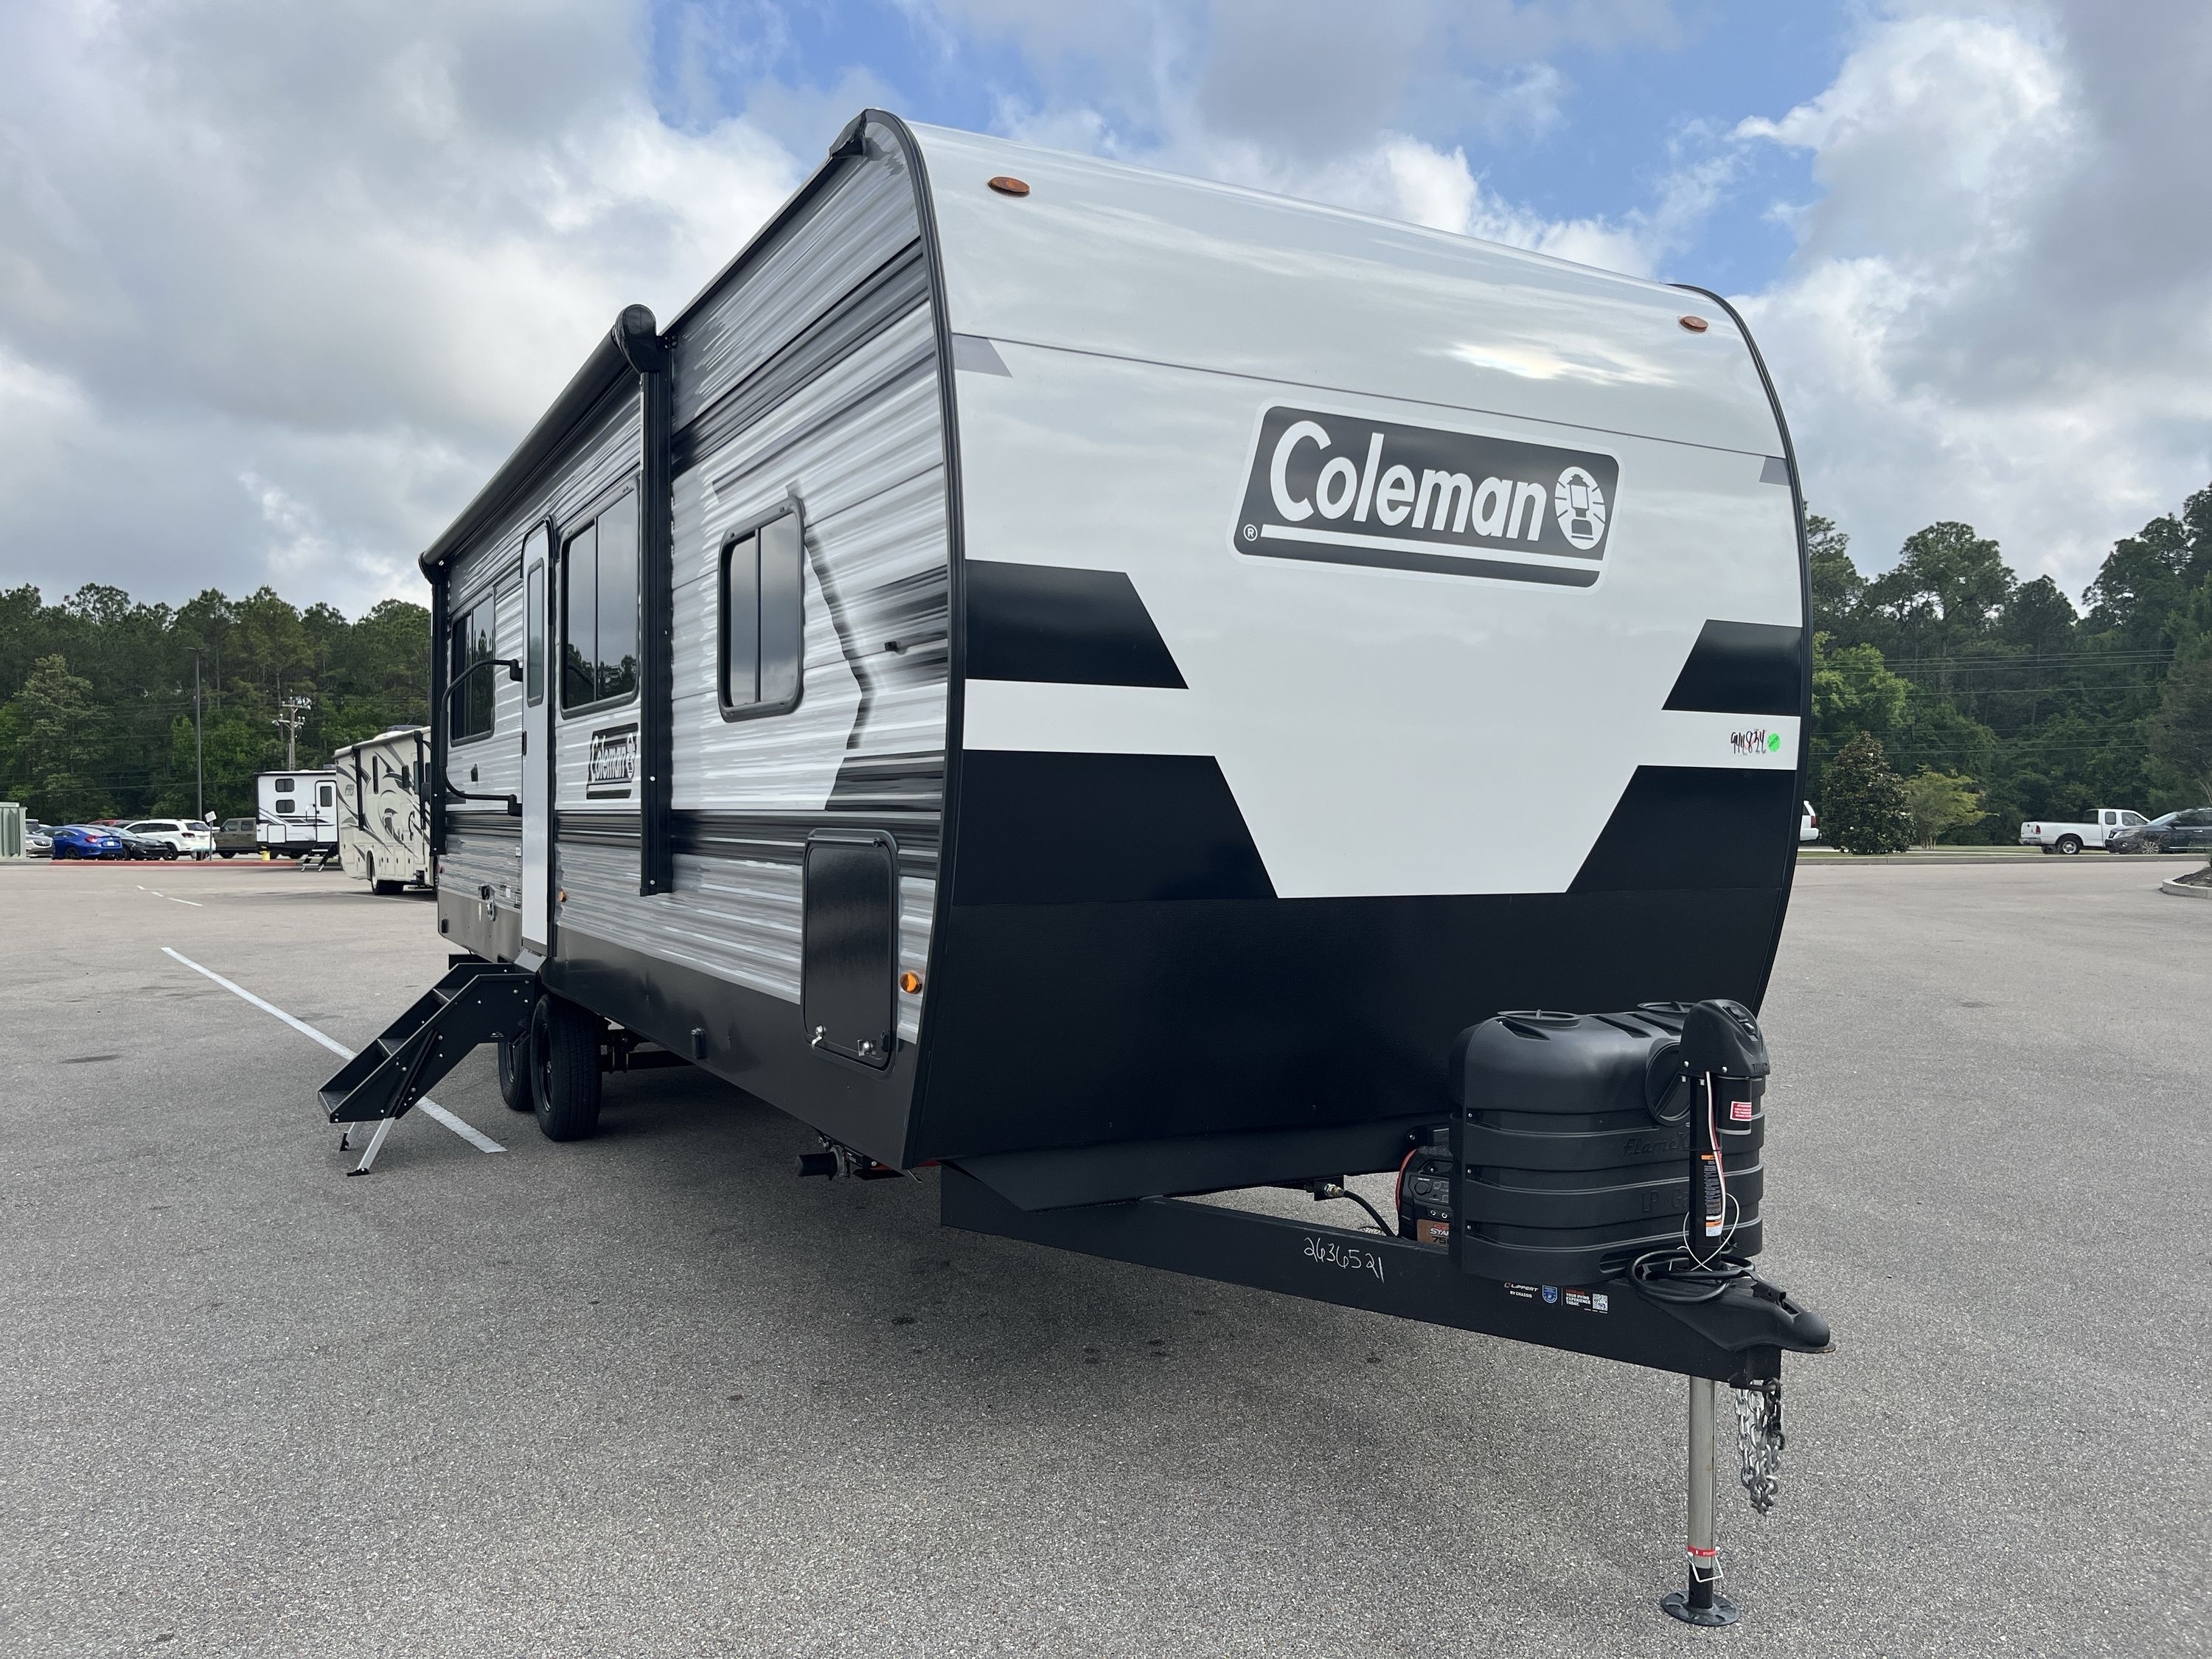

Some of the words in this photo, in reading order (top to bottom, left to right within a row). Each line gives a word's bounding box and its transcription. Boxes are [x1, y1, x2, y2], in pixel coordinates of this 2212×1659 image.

[1269, 420, 1547, 542] Coleman
[591, 735, 627, 783] Coleman
[1671, 1186, 1690, 1208] Ga
